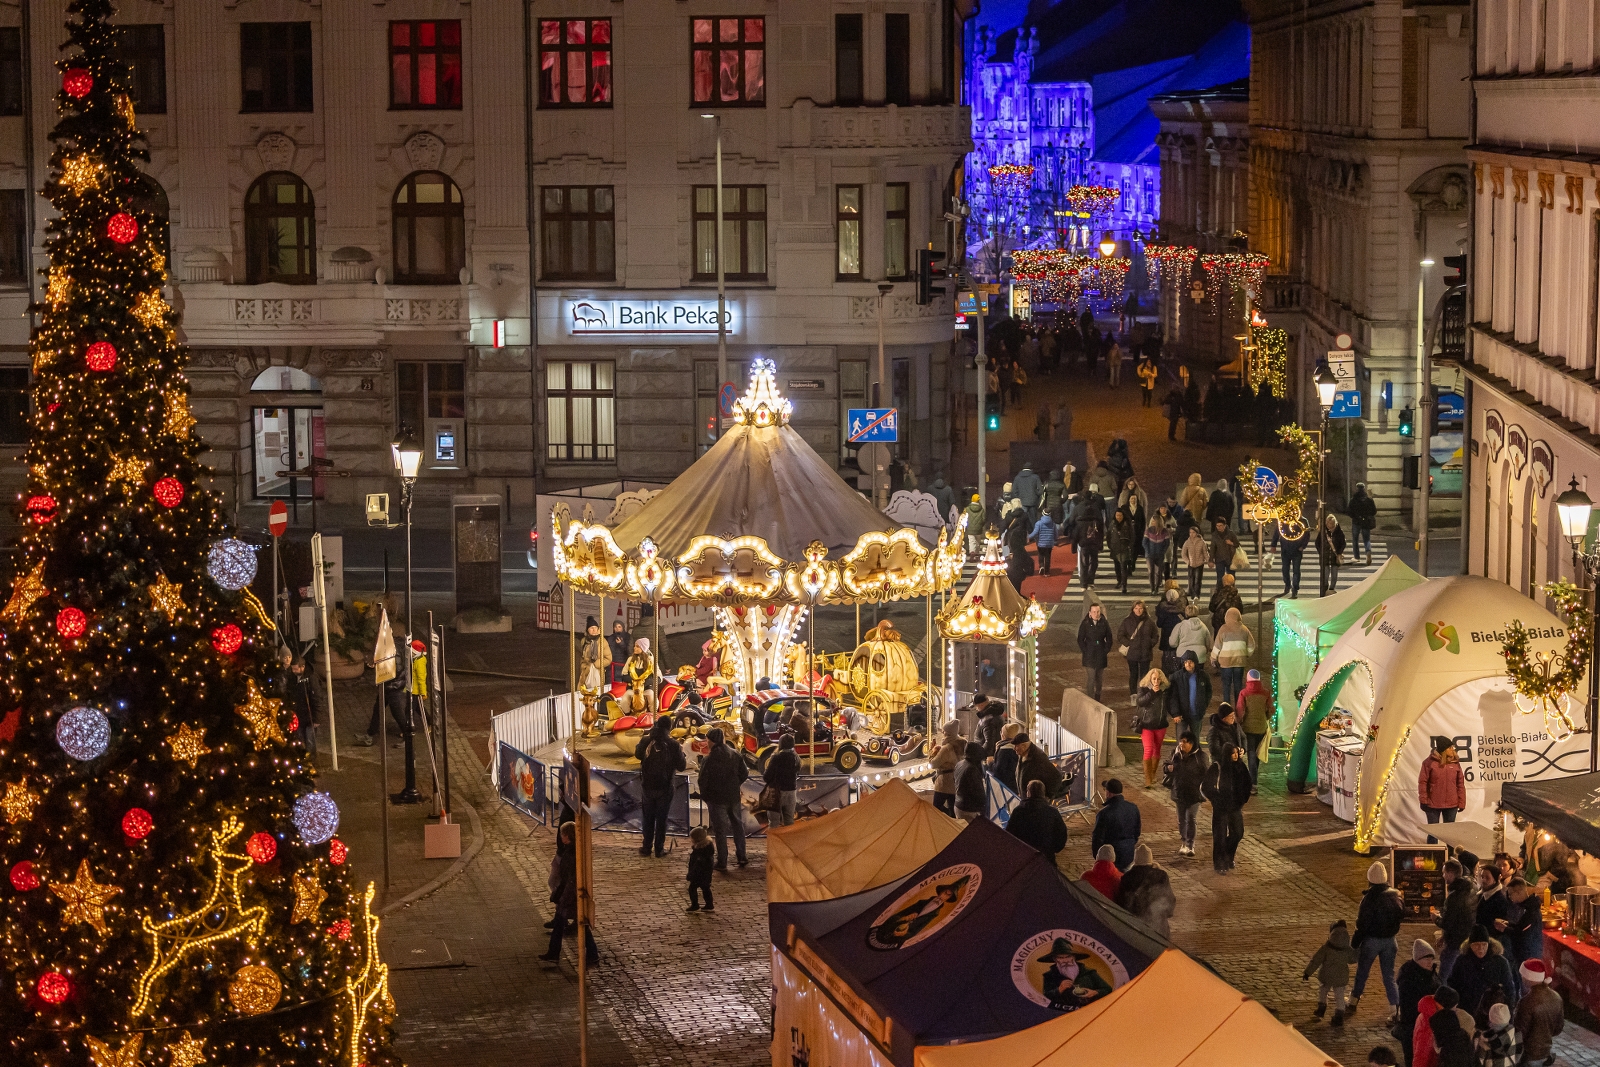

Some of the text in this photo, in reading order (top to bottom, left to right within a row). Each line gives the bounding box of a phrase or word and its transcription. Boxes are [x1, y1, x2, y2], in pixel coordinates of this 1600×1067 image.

[620, 306, 732, 324] Bank Pekao
[1477, 732, 1548, 745] Bielsko-Biała
[1478, 747, 1513, 757] Polska
[1478, 759, 1516, 769] Stolica
[1480, 771, 1518, 783] Kultury
[920, 866, 976, 888] MAGICZNY
[1014, 931, 1120, 972] MAGICZNY STRAGAN
